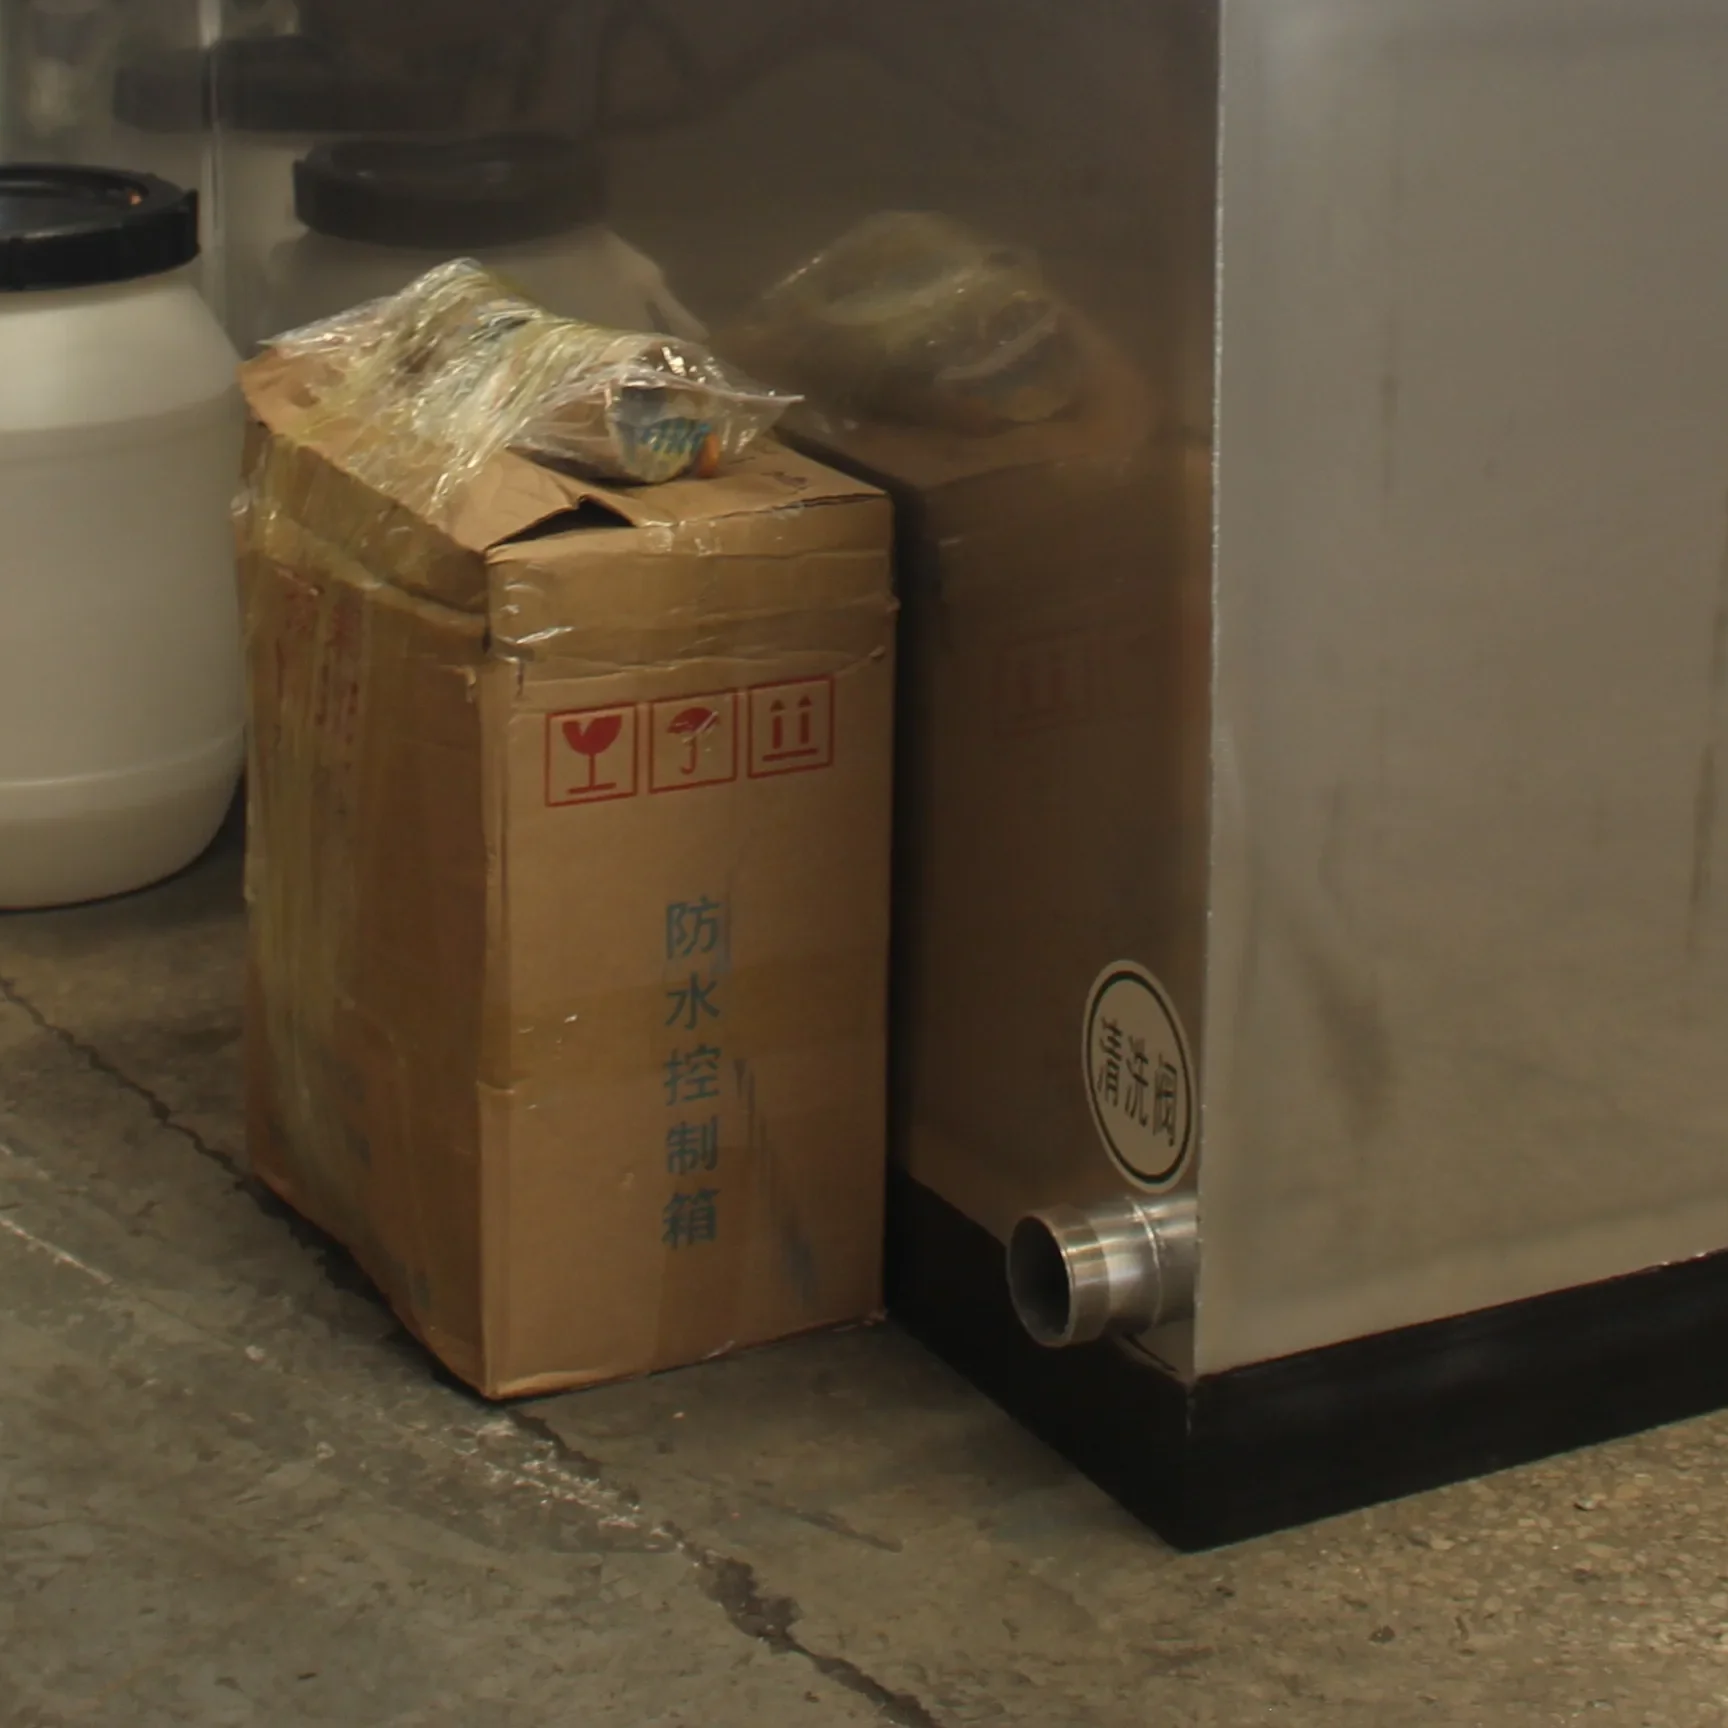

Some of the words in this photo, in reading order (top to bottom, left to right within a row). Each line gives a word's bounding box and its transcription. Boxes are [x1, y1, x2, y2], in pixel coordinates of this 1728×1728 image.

[662, 895, 722, 1249] 防水控制箱
